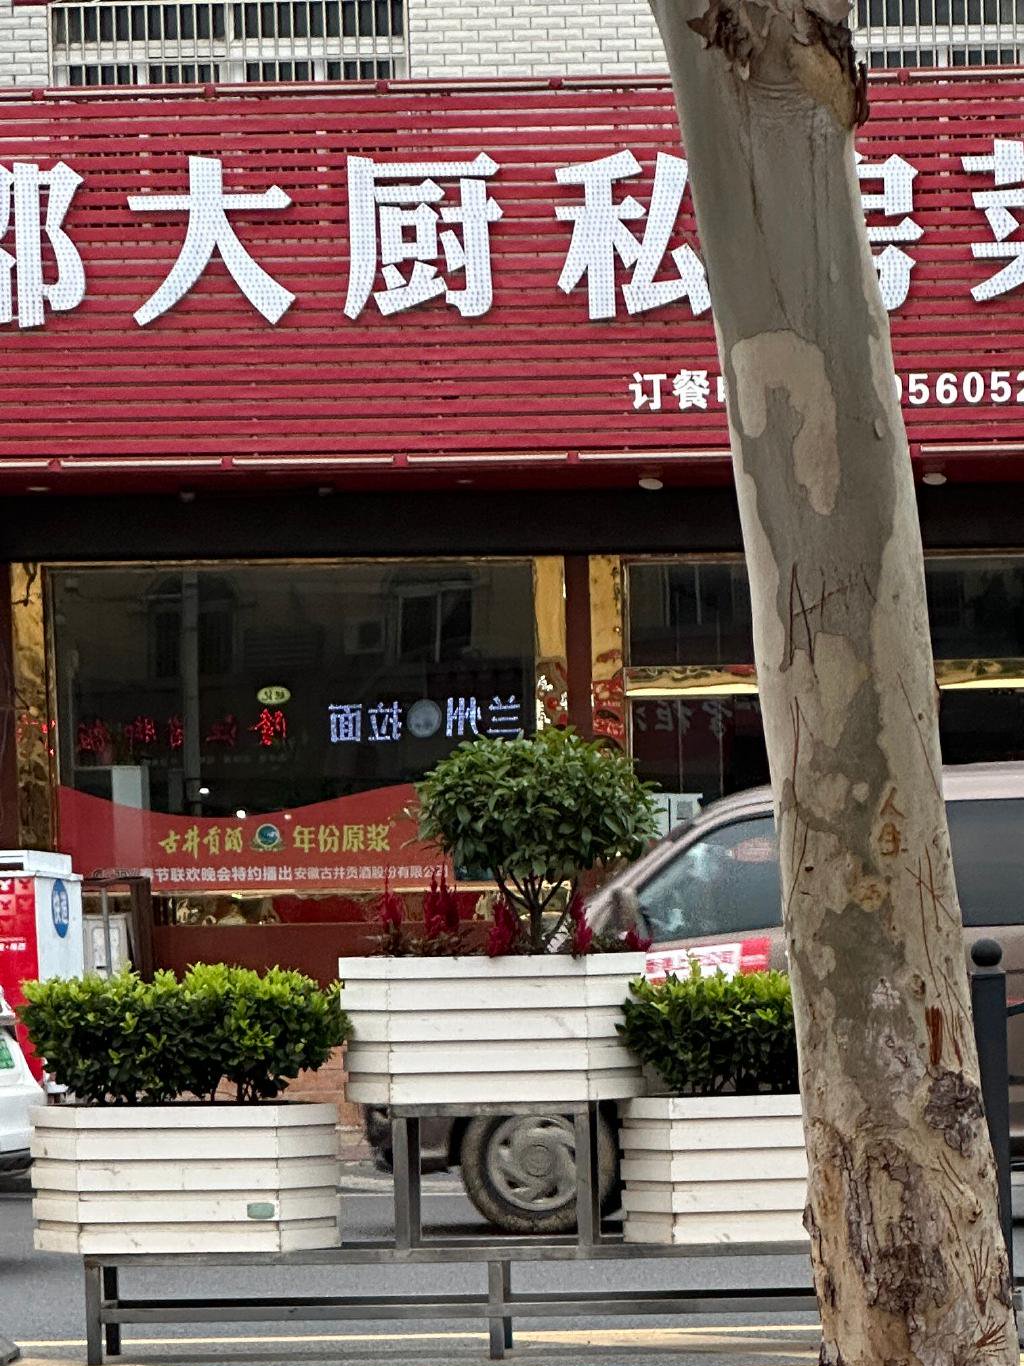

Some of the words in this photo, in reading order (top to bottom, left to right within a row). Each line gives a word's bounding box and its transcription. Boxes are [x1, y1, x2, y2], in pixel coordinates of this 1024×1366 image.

[628, 369, 729, 410] 订餐
[158, 825, 243, 860] 古井贡酒
[292, 824, 391, 853] 年份原浆
